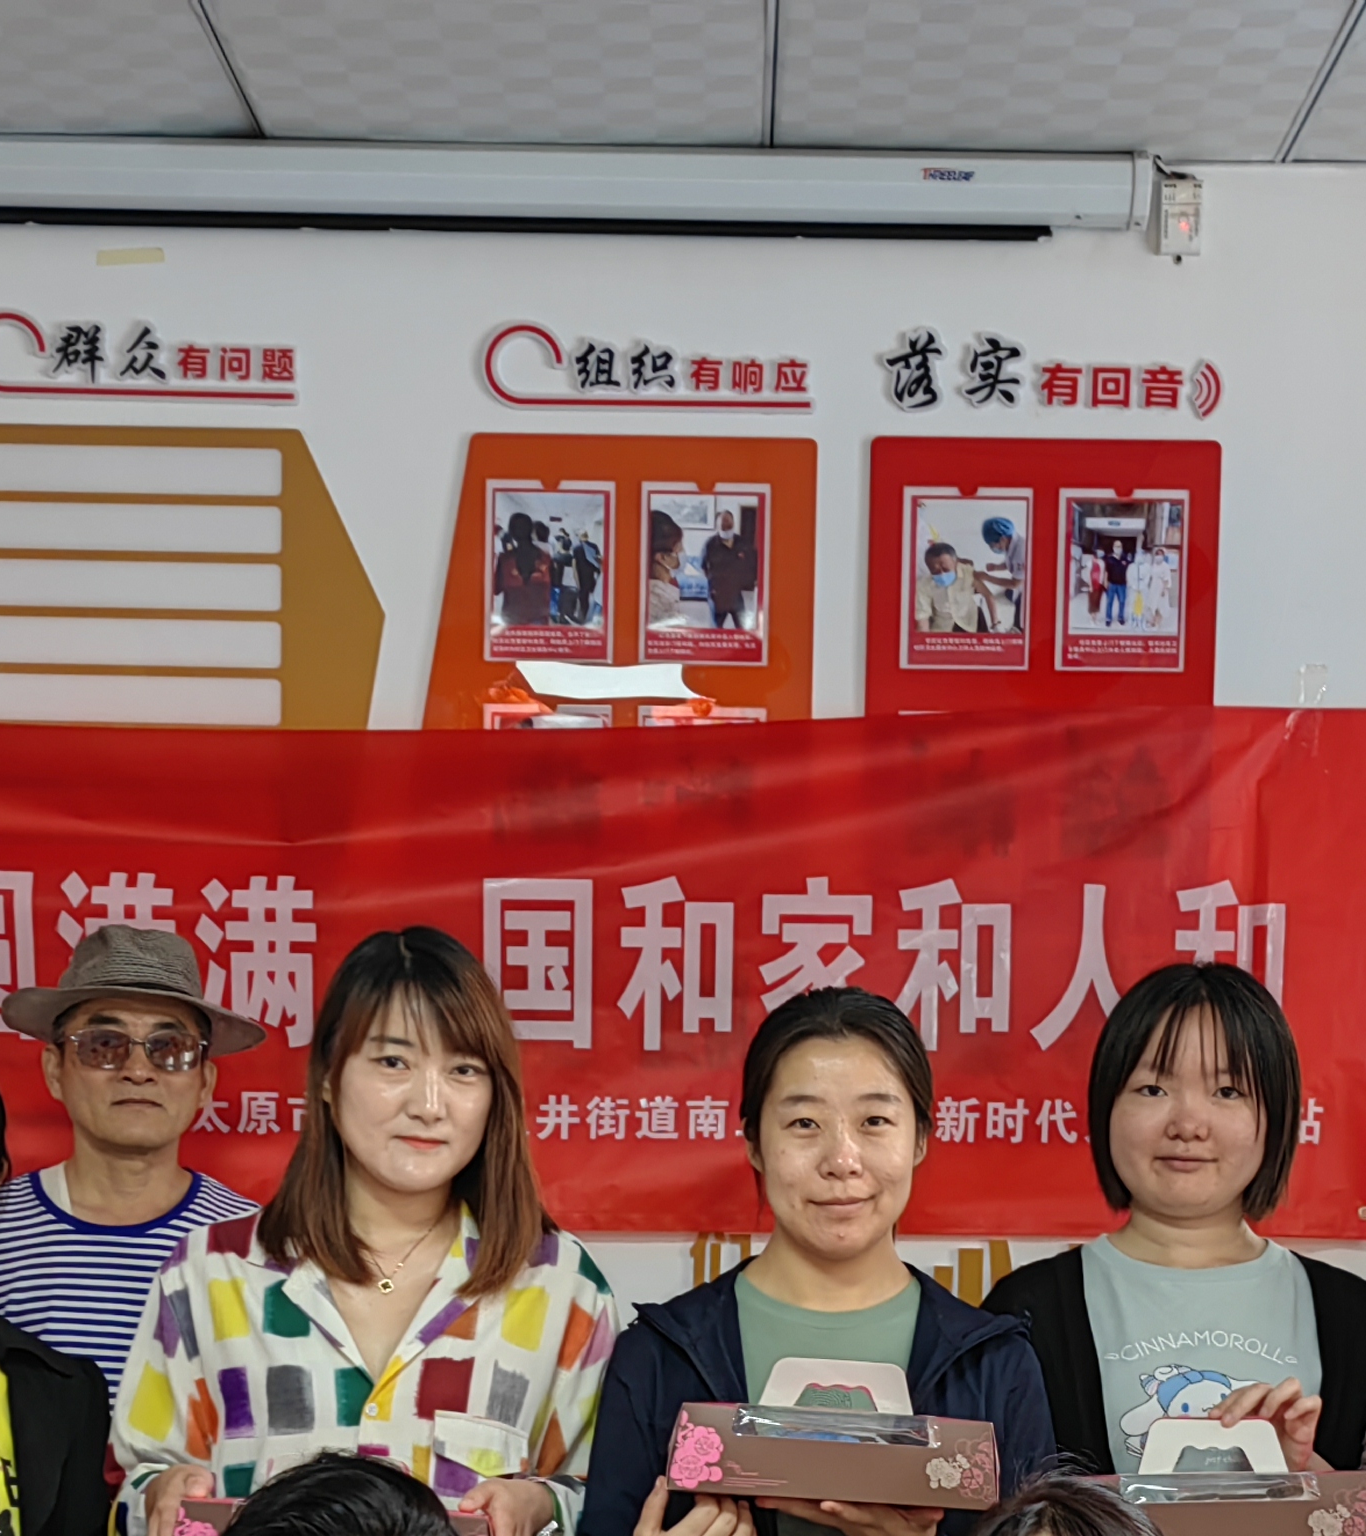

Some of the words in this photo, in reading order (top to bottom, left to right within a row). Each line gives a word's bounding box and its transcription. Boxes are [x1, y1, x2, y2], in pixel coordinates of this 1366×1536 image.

[52, 325, 296, 384] 群众有问题
[574, 341, 809, 395] 组织有响应
[886, 328, 1184, 411] 落实有回音
[526, 1094, 743, 1140] 井街道南
[935, 1095, 1090, 1144] 新时代
[1120, 1330, 1285, 1365] CINNAMOROLL
